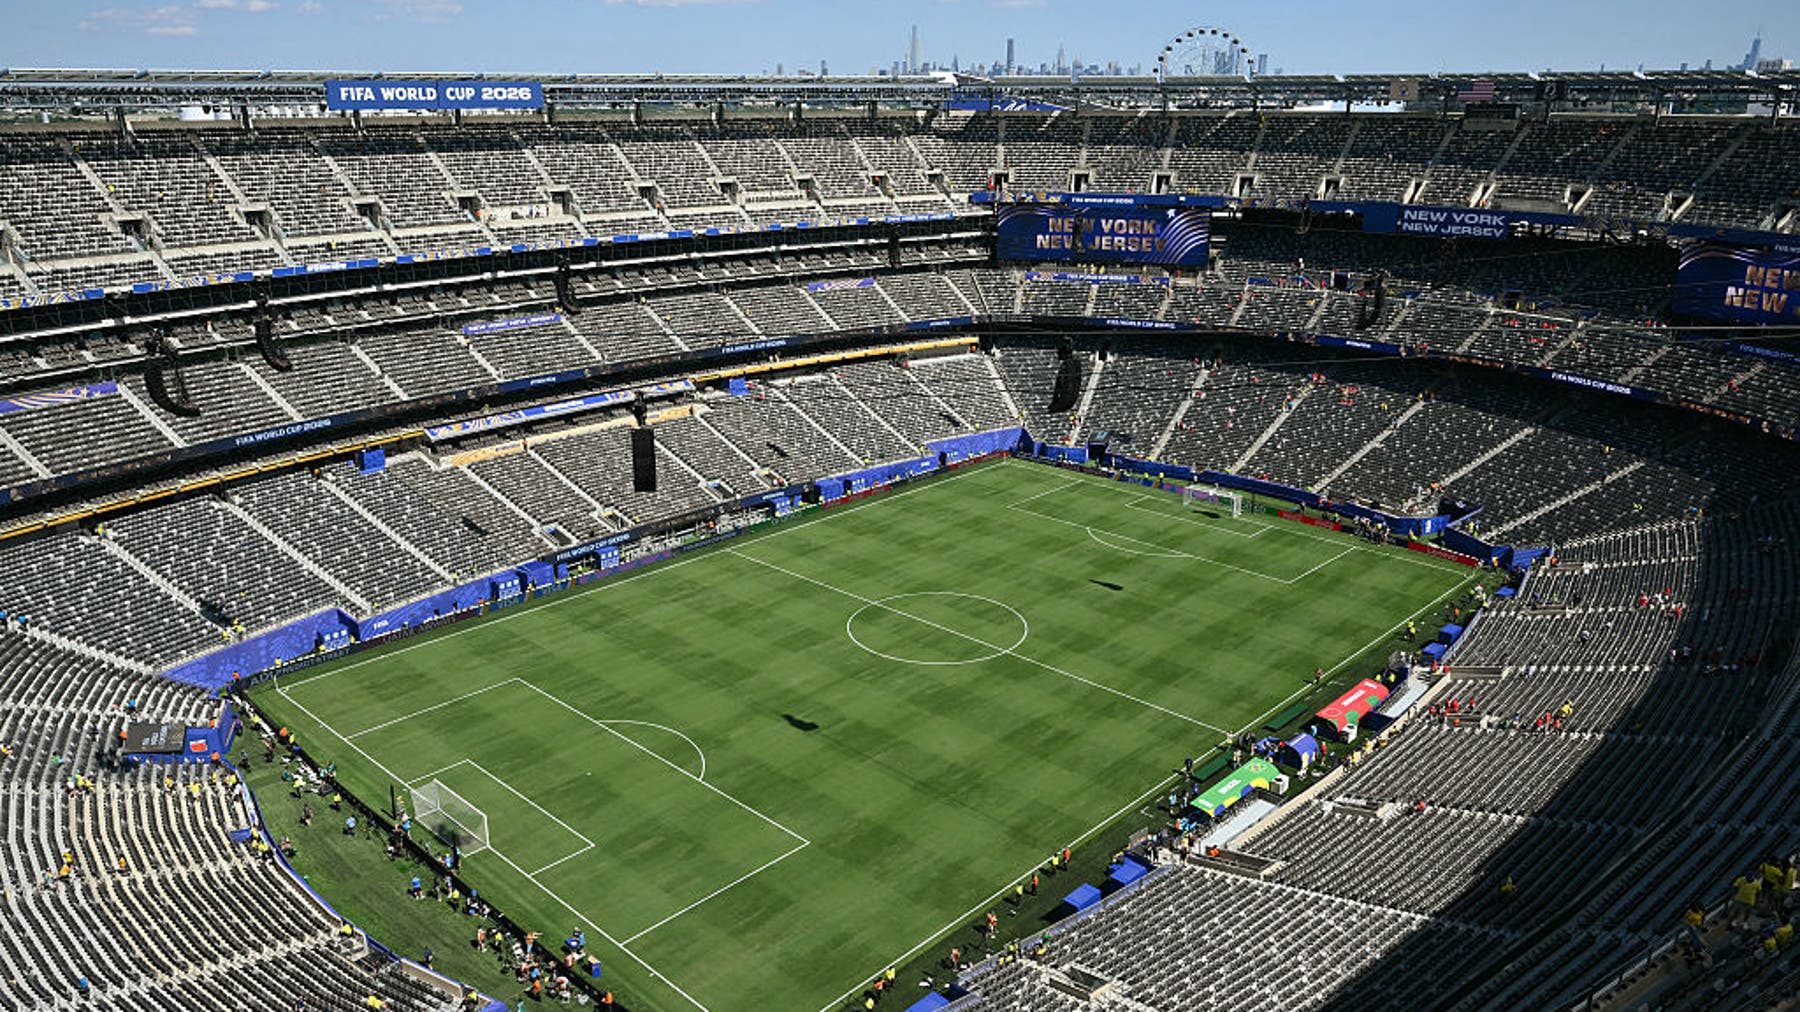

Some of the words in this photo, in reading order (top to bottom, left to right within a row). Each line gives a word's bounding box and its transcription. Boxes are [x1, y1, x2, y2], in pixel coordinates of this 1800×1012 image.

[340, 87, 375, 100] FIFA
[380, 87, 437, 100] WORLD
[446, 87, 475, 100] CUP
[481, 87, 532, 100] 2026
[1404, 210, 1447, 222] NEW
[1451, 212, 1506, 226] YORK
[1101, 219, 1157, 235] YORK
[1402, 222, 1439, 233] NEW
[1441, 225, 1504, 238] JERSEY
[1088, 236, 1167, 251] JERSEY
[1724, 286, 1788, 313] NEW
[255, 429, 285, 442] WORLD
[286, 424, 303, 435] CUP
